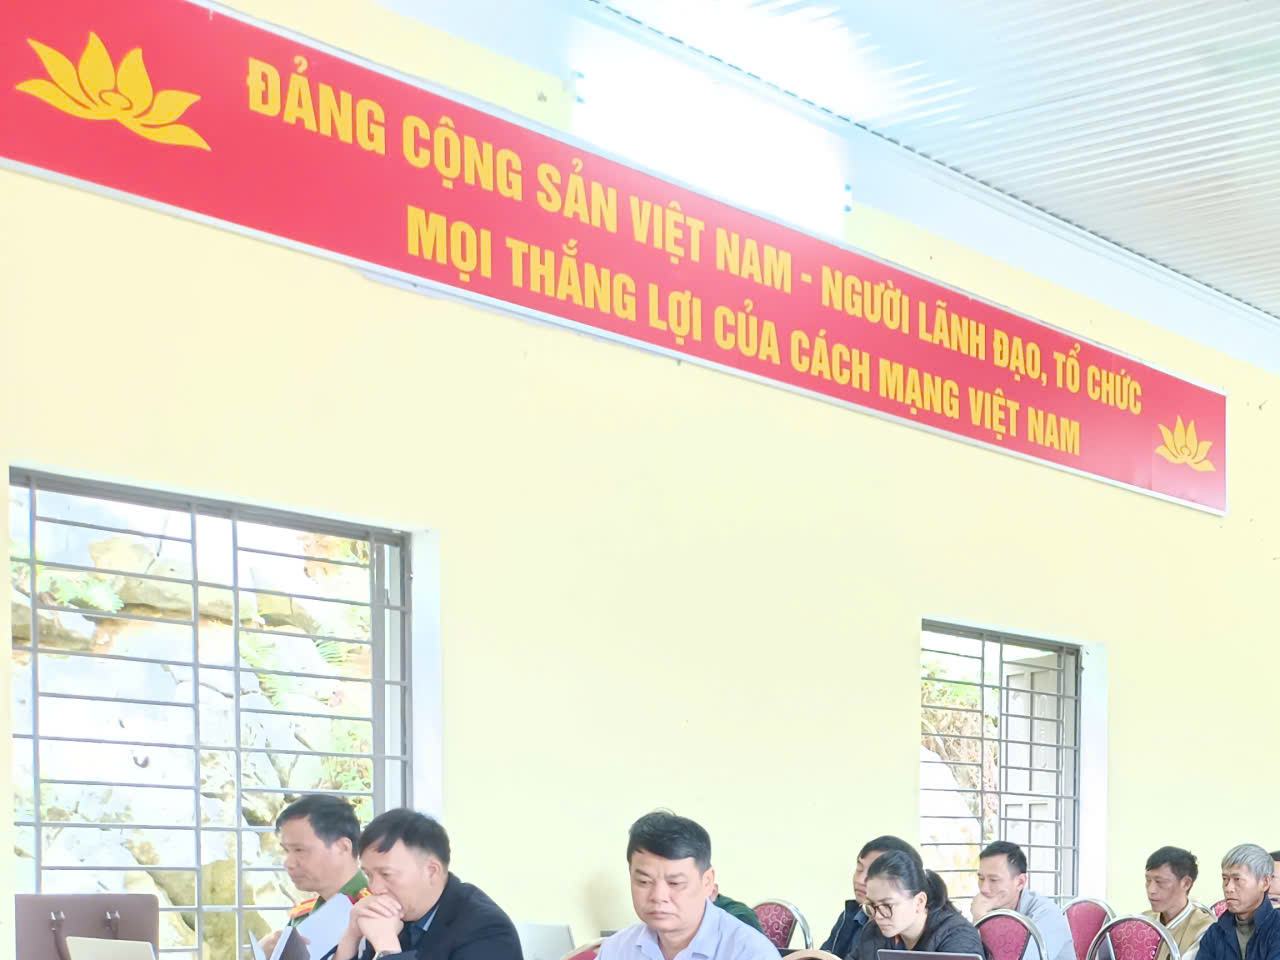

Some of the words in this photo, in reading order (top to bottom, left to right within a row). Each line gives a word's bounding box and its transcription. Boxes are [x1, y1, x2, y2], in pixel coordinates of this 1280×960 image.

[246, 56, 386, 155] ĐẢNG
[402, 116, 523, 201] CỘNG
[537, 158, 618, 233] SẢN
[630, 196, 705, 264] VIỆT
[716, 228, 792, 294] NAM
[822, 265, 910, 334] NGƯỜI
[918, 293, 986, 361] LÃNH
[992, 330, 1048, 385] ĐẠO,
[1053, 343, 1081, 393] TỔ
[1086, 362, 1142, 415] CHỨC
[407, 205, 492, 283] MỌI
[505, 238, 637, 321] THẮNG
[648, 282, 702, 345] LỢI
[714, 300, 781, 365] CỦA
[790, 327, 871, 393] CÁCH
[879, 358, 960, 419] MẠNG
[968, 388, 1020, 441] VIỆT
[1027, 407, 1081, 456] NAM
